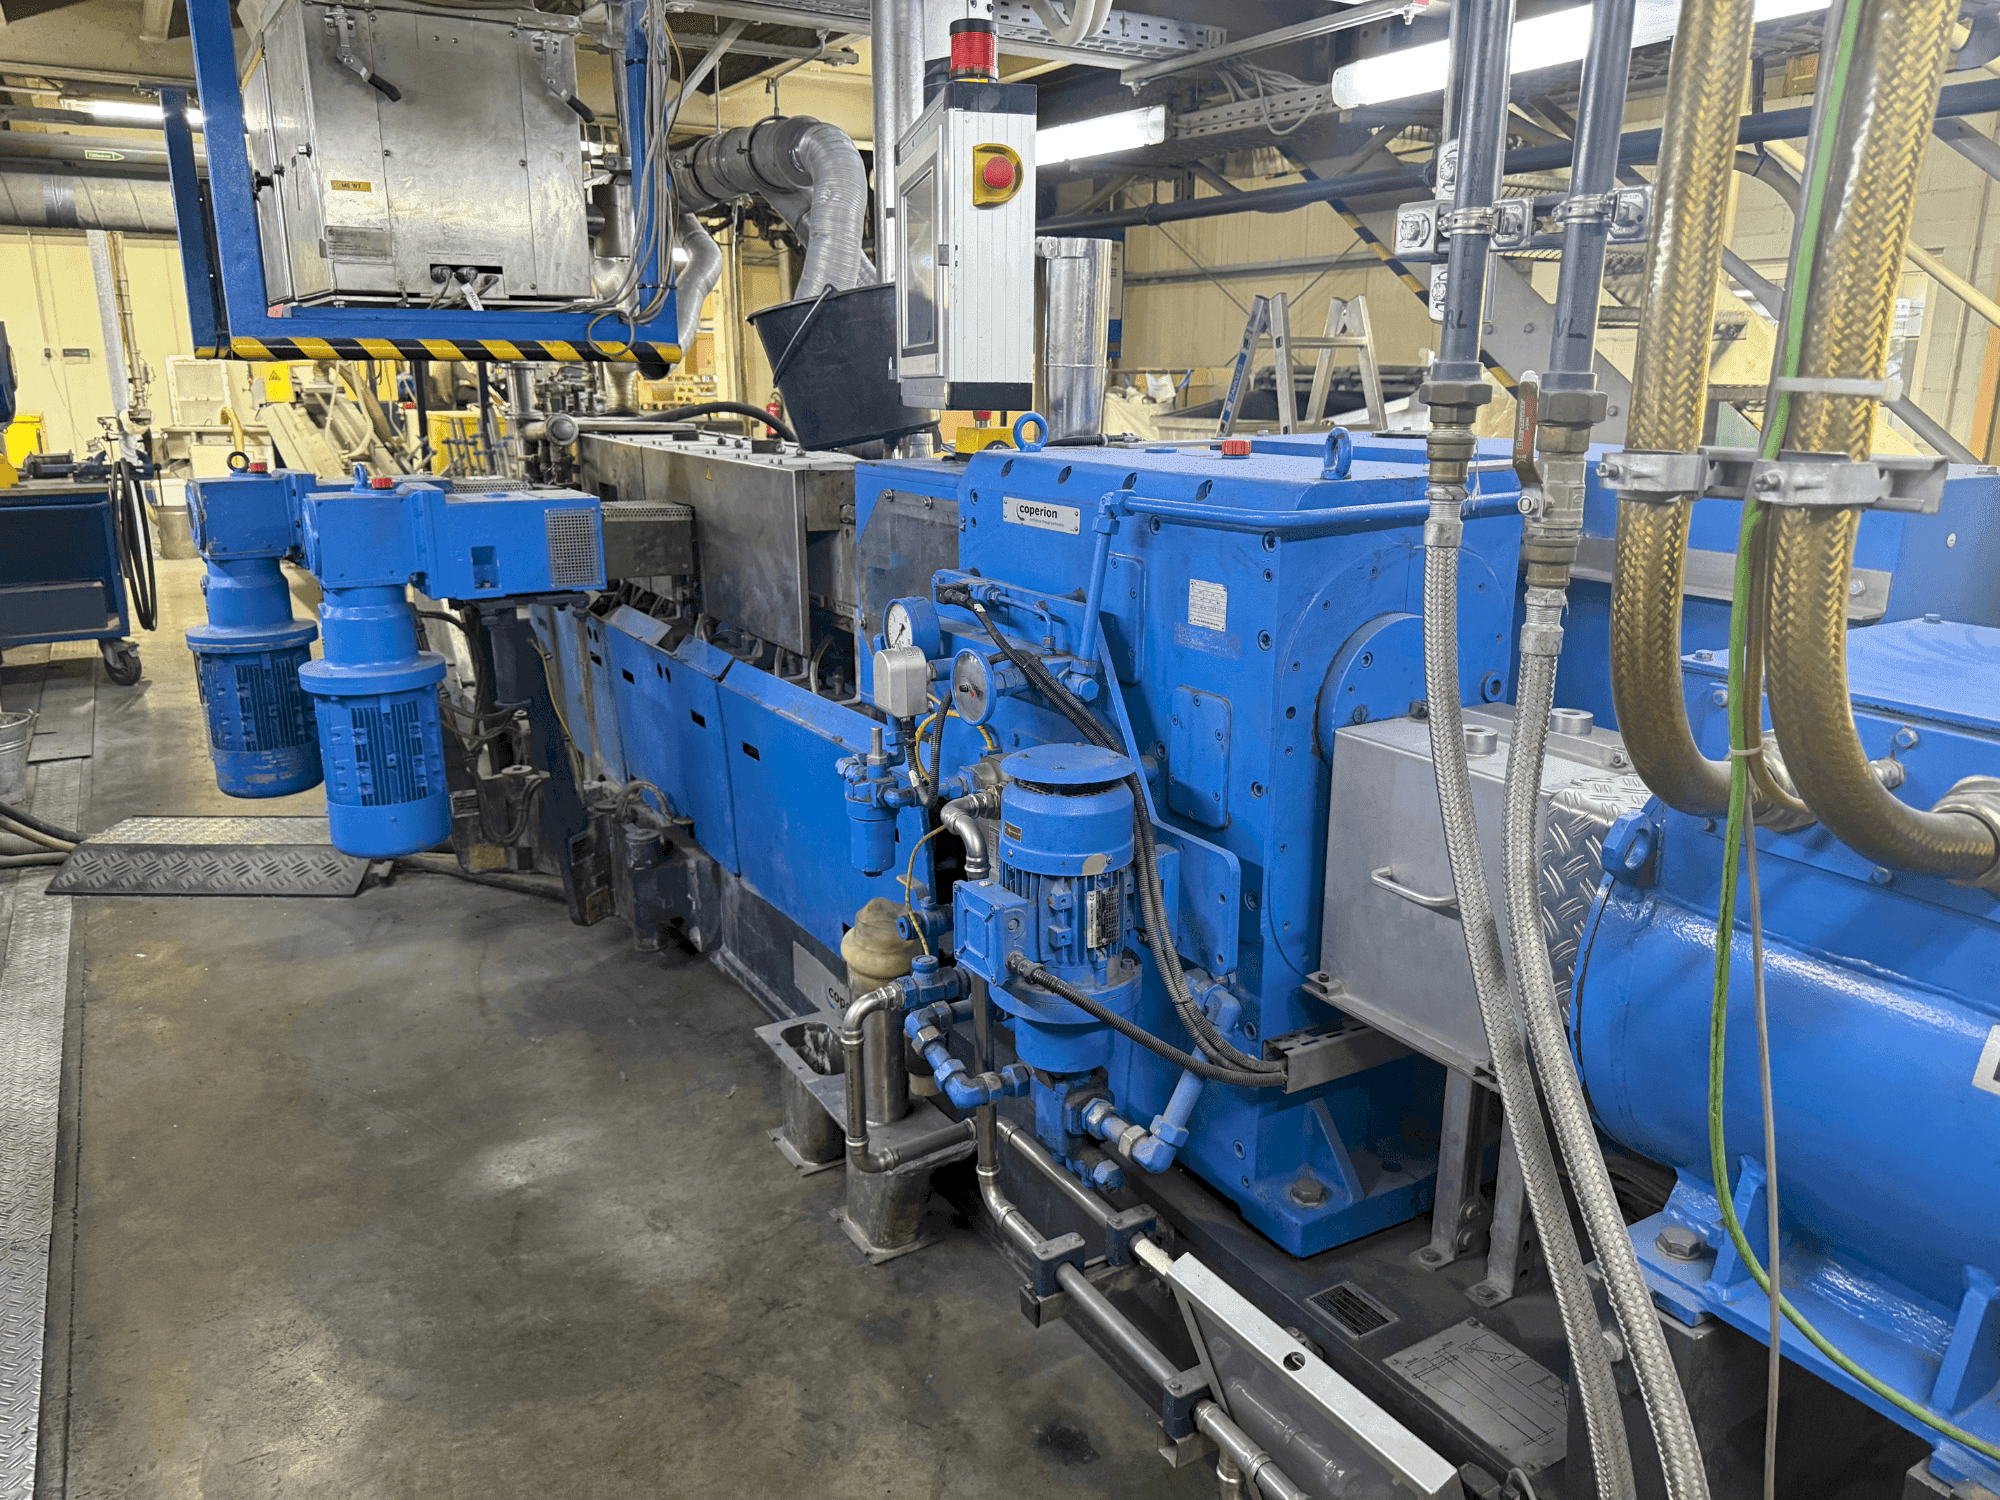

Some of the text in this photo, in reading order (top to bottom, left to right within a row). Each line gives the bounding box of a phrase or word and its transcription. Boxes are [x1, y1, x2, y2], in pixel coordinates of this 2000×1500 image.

[1444, 309, 1468, 330] RL
[1556, 317, 1587, 339] VL
[1019, 504, 1058, 519] coperion
